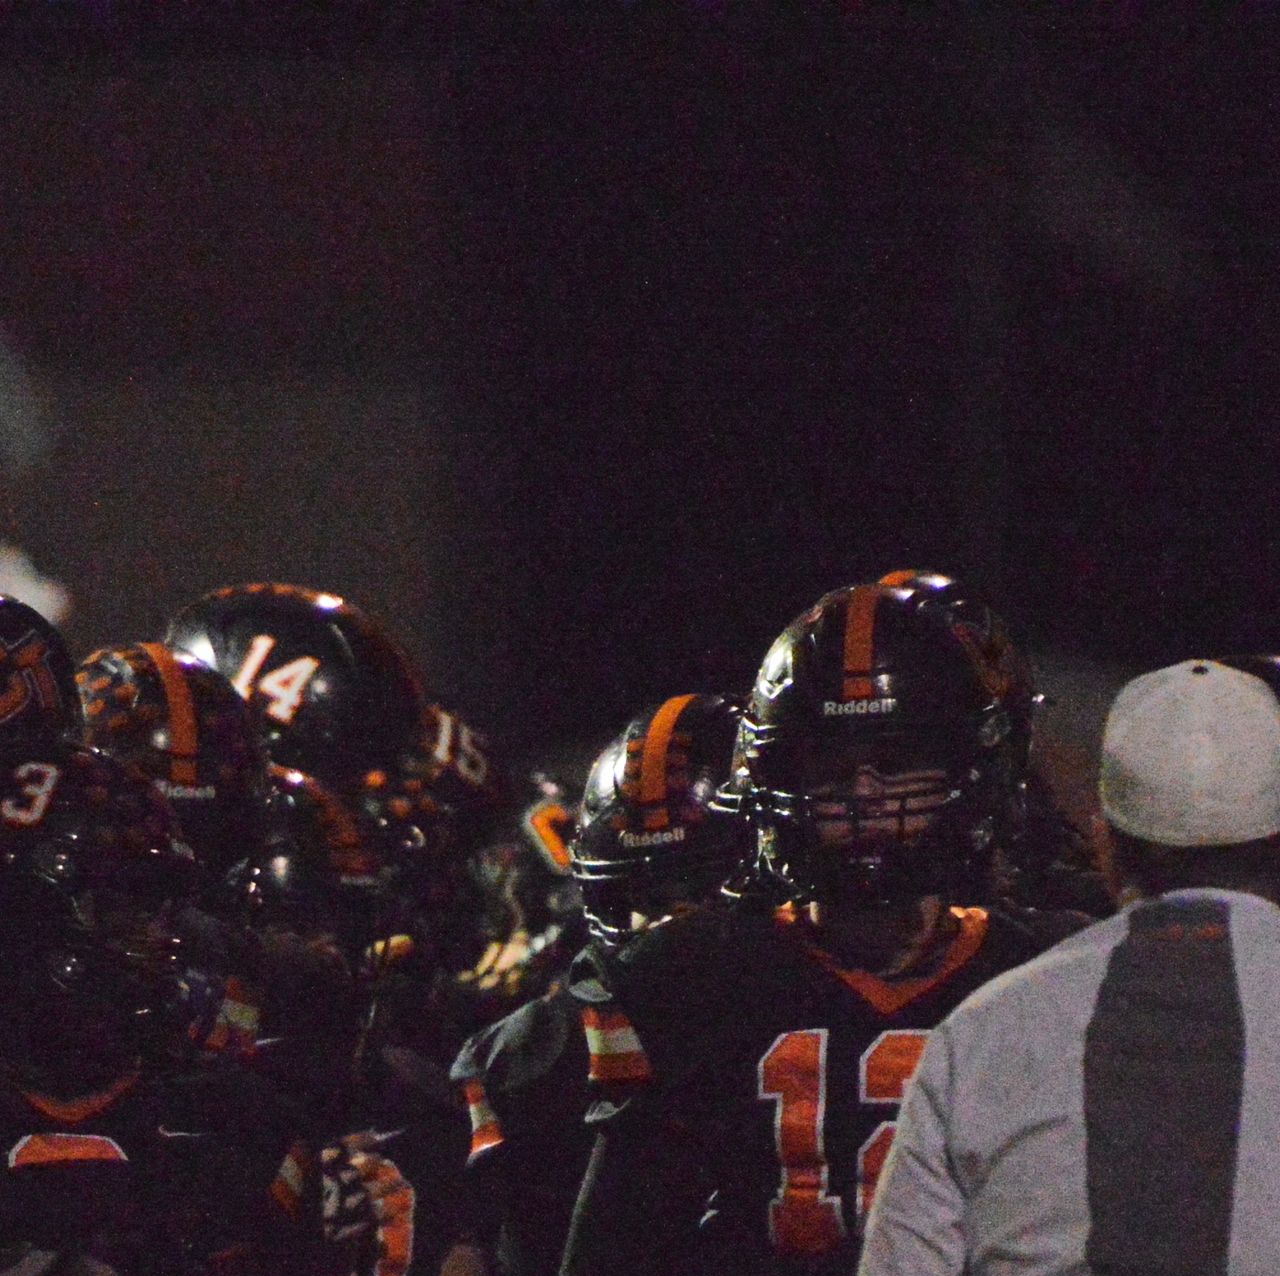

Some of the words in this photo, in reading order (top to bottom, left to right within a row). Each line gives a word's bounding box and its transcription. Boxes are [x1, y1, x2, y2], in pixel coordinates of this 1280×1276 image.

[230, 633, 320, 727] 14
[823, 697, 897, 717] Riddell
[1, 760, 62, 829] 3
[622, 826, 687, 848] Riddell
